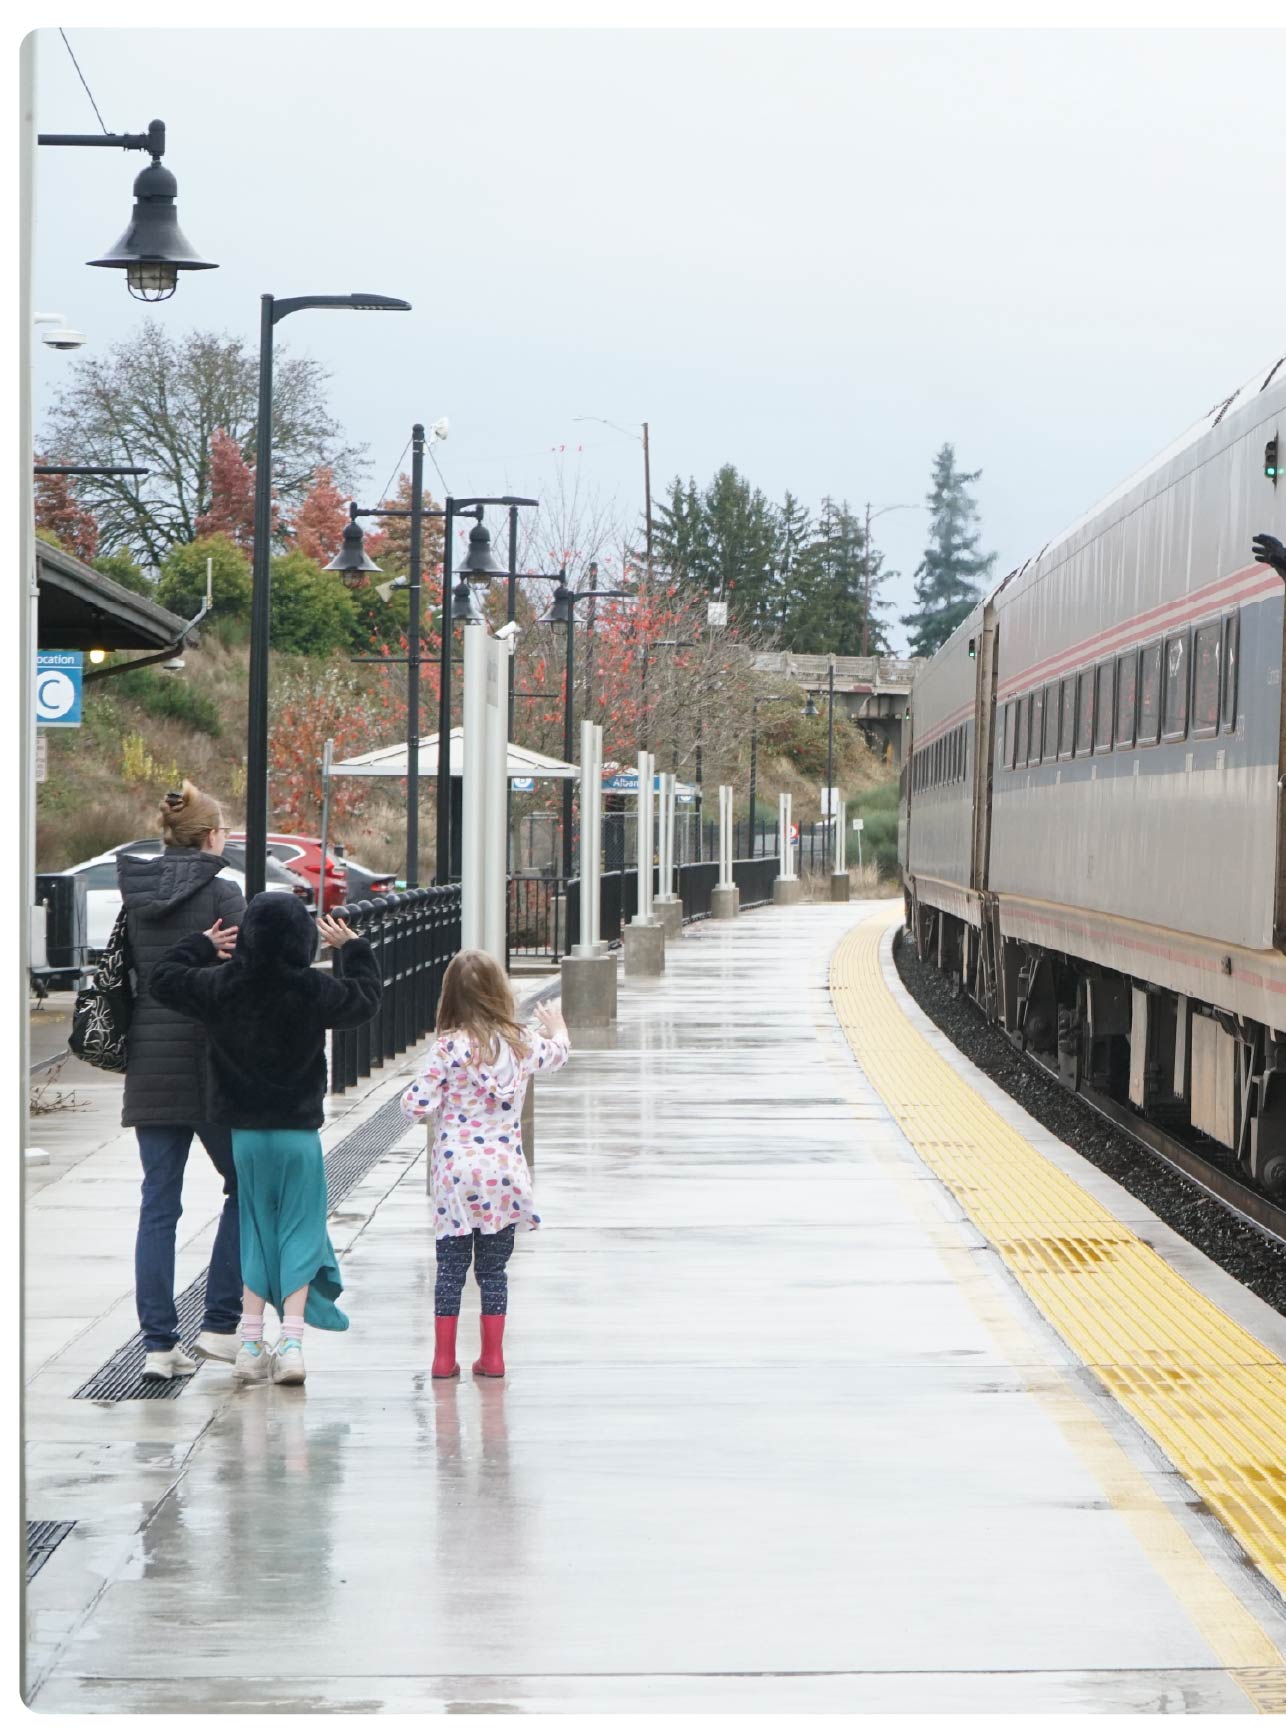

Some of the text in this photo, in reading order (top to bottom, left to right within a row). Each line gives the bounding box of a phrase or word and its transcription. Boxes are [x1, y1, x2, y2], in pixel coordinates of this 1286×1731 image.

[37, 654, 75, 664] ocation
[38, 679, 60, 709] C
[613, 777, 639, 788] Alban
